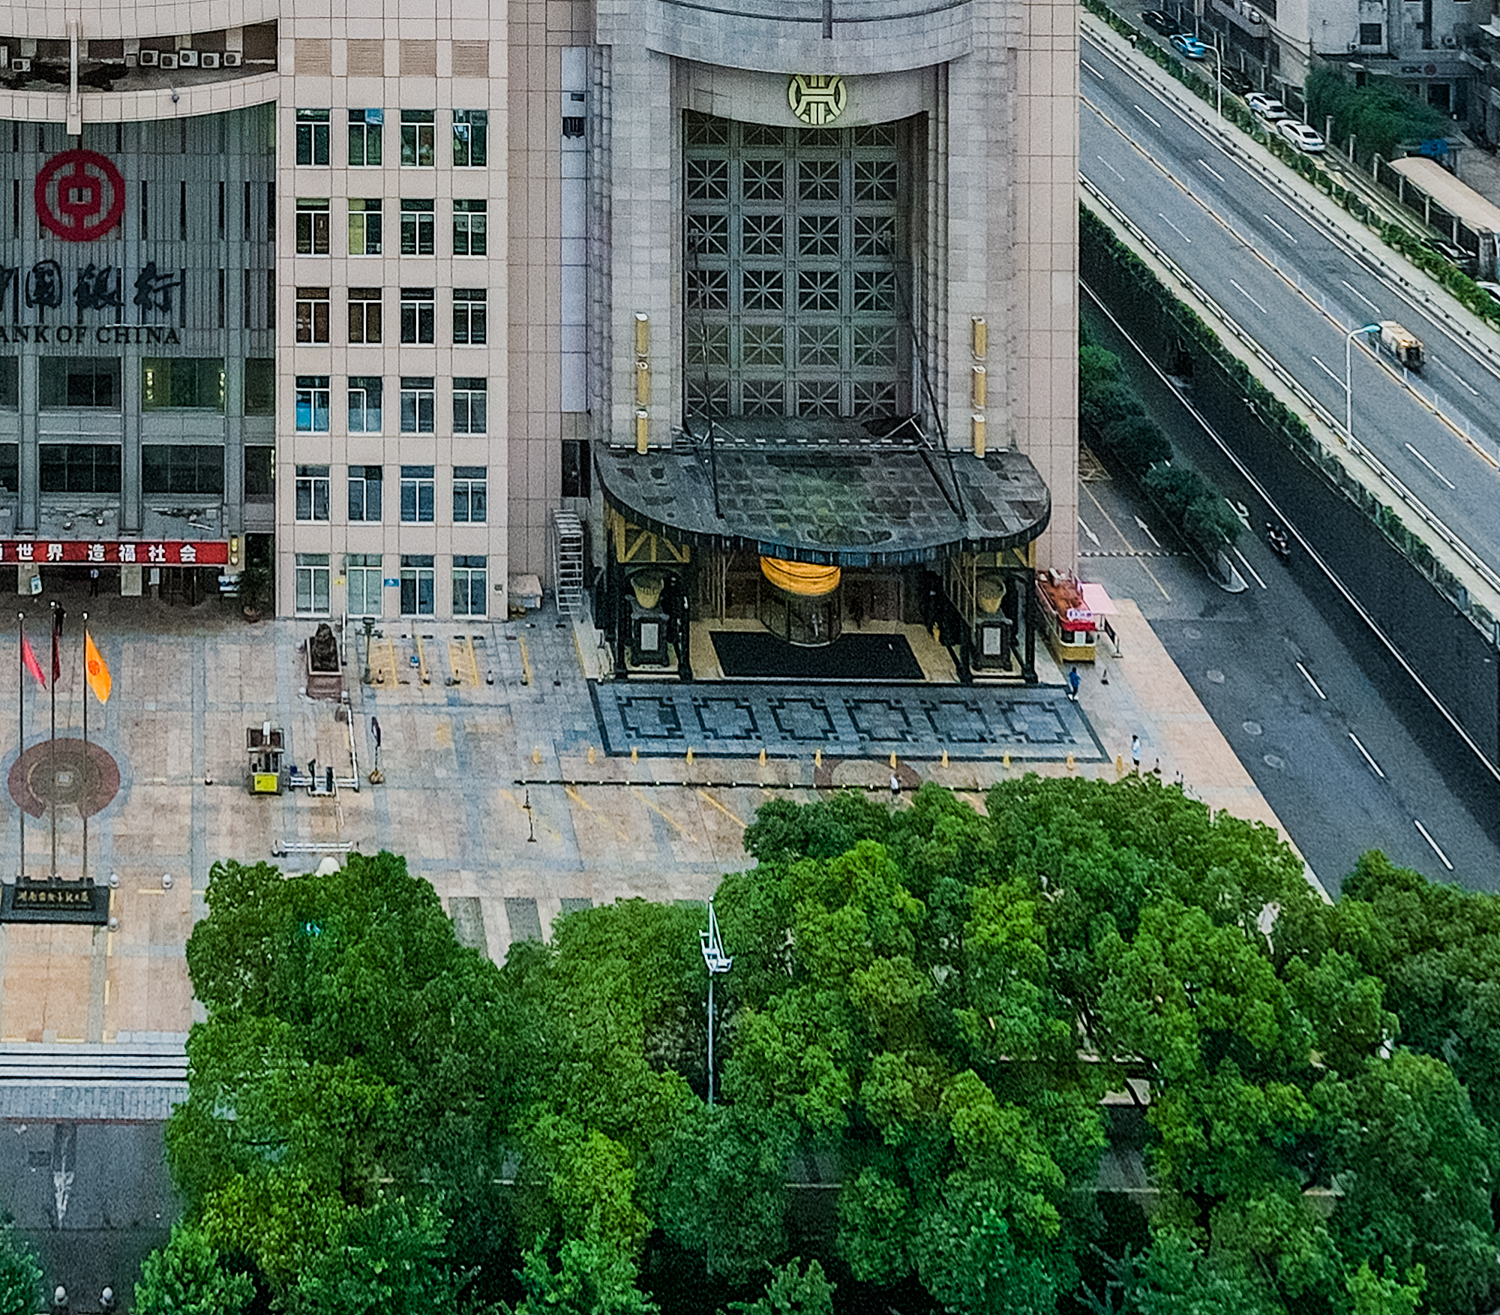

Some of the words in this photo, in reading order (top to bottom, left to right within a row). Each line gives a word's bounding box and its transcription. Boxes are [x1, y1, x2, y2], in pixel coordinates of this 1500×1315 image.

[56, 326, 86, 344] OF
[96, 326, 181, 344] CHINA
[87, 543, 198, 562] 造福社会
